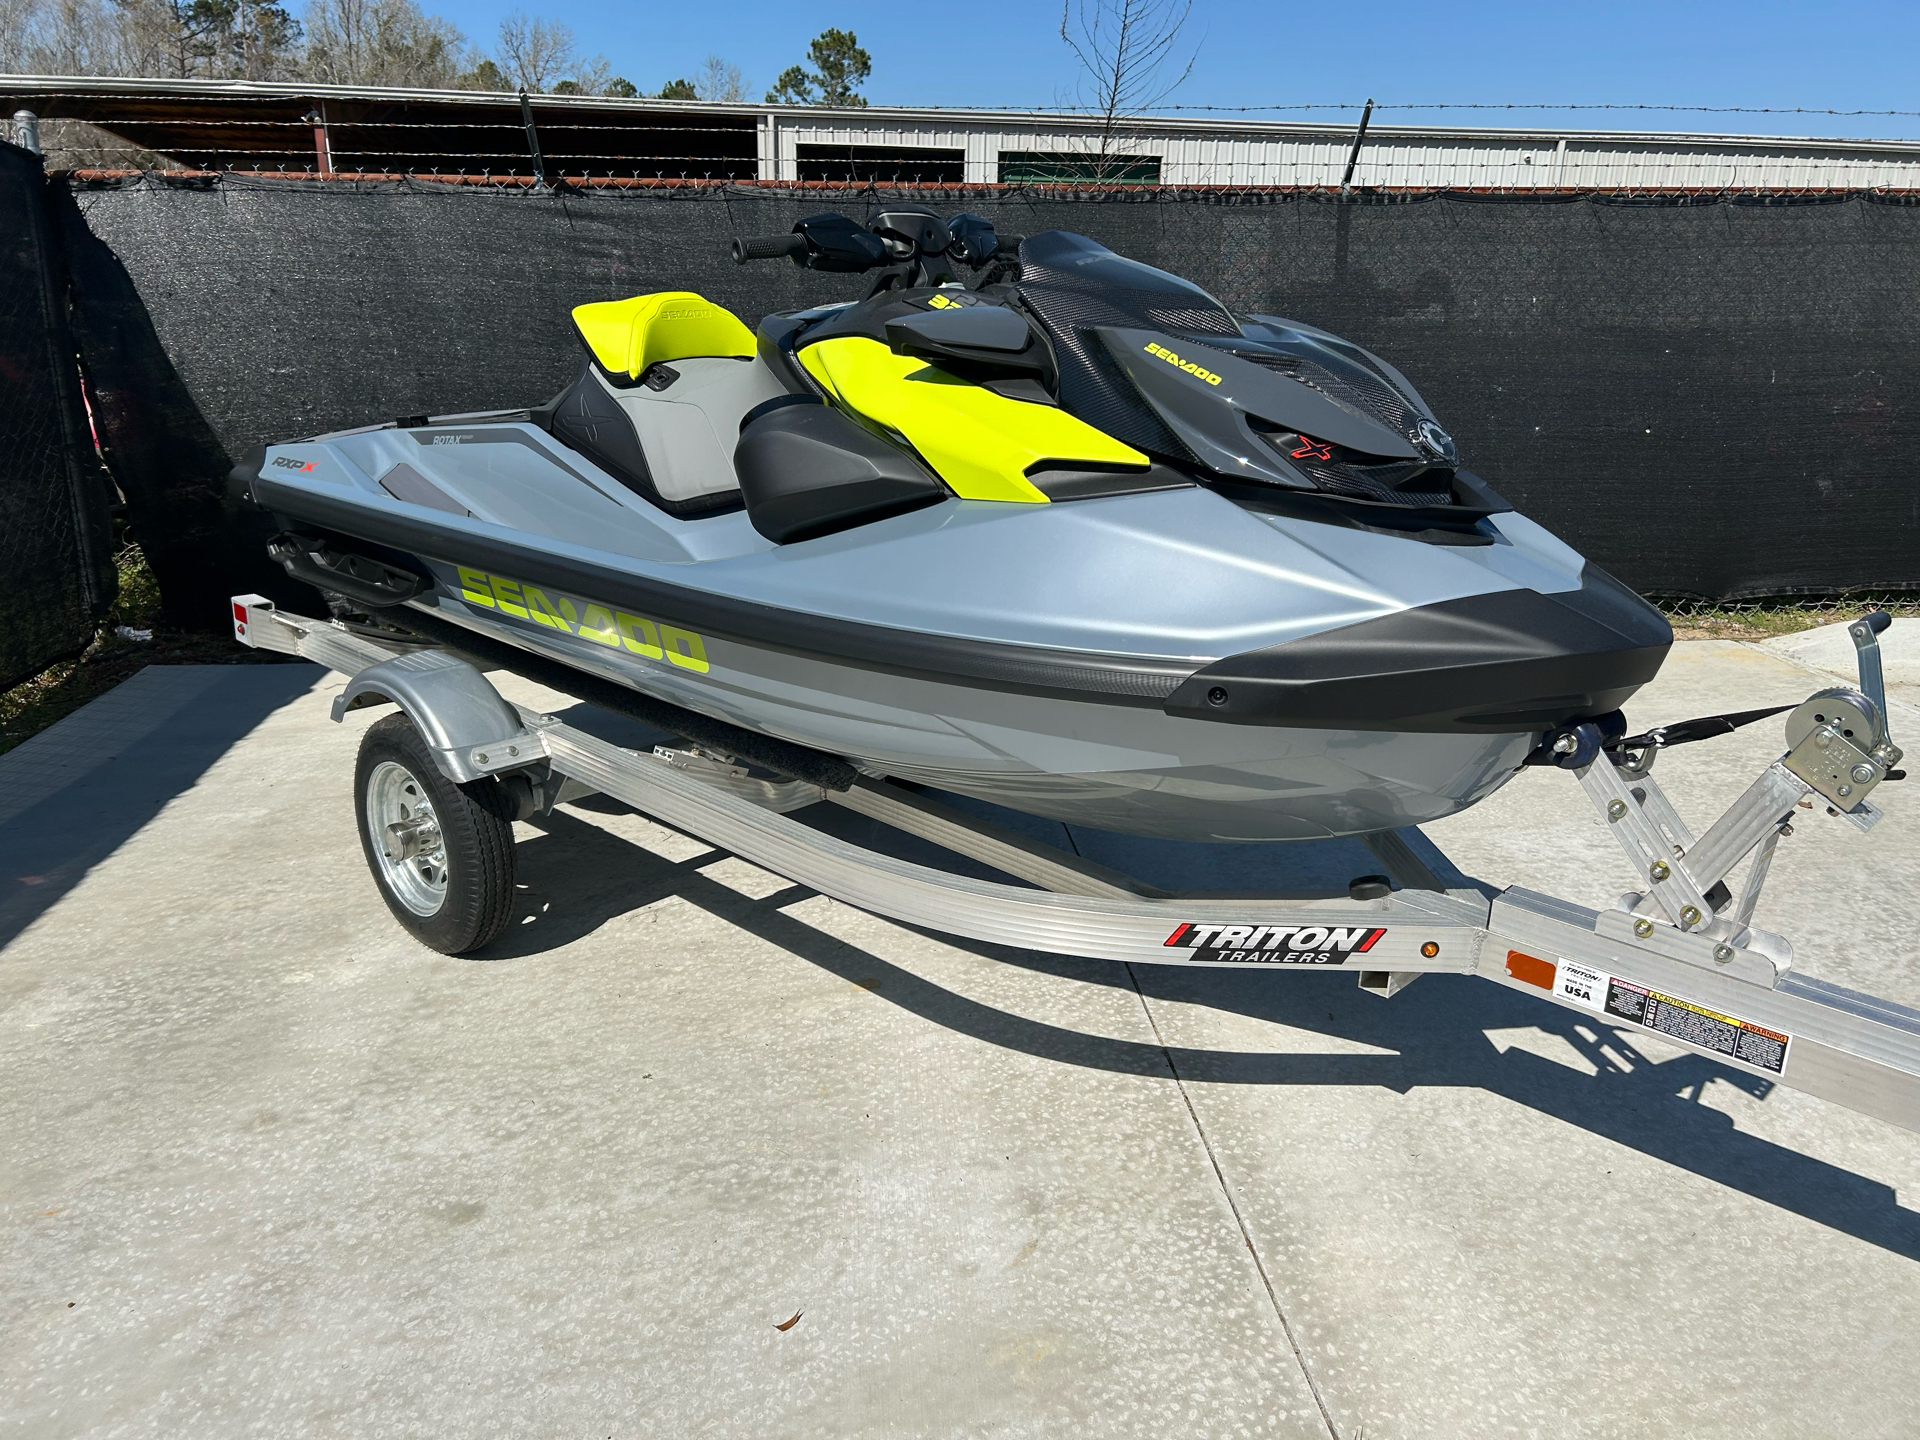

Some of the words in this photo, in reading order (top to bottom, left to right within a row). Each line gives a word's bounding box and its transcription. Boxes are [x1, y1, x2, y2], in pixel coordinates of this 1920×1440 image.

[433, 435, 461, 446] ROTAX
[1188, 924, 1368, 951] TRITON
[1217, 950, 1331, 964] TRAILERS
[1566, 966, 1599, 981] TRITON
[1564, 984, 1591, 1001] USA
[1618, 980, 1648, 996] DANGER
[1658, 994, 1690, 1010] CAUTION
[1749, 1023, 1785, 1042] WARNING
